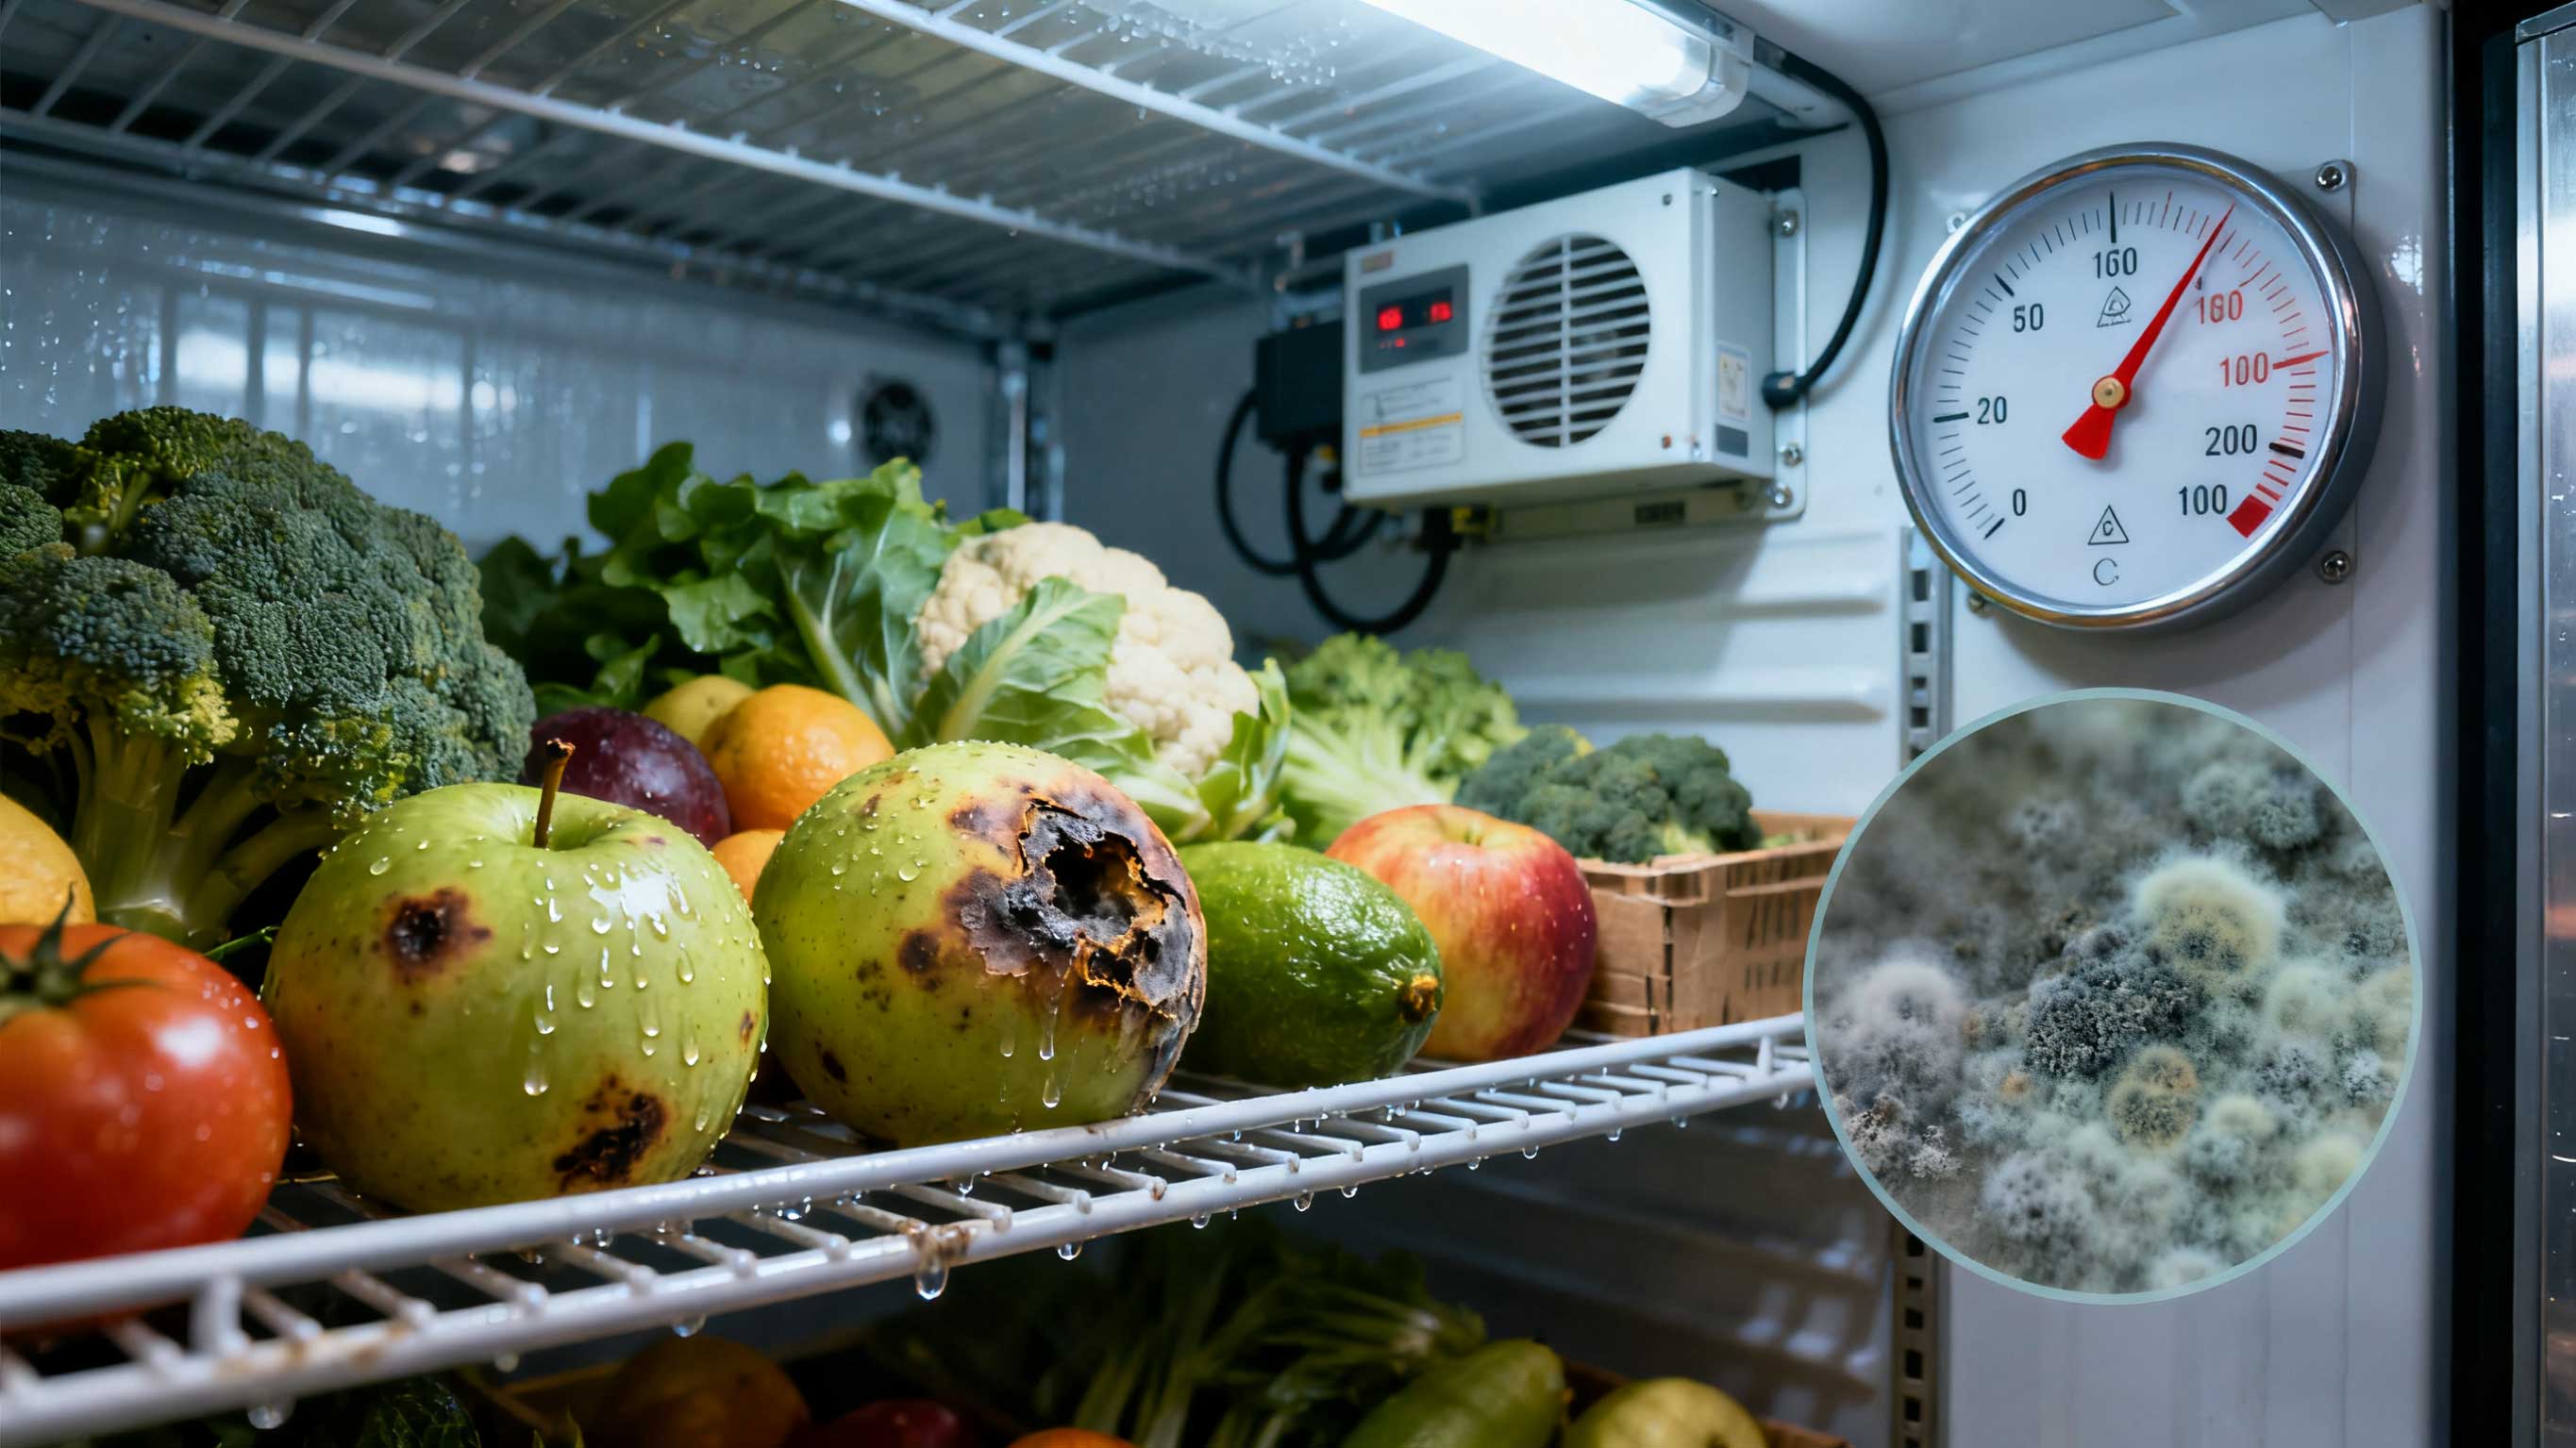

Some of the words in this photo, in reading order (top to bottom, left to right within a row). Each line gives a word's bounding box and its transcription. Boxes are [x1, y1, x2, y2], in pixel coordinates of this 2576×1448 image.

[2014, 303, 2044, 333] 50
[2219, 352, 2268, 387] 100
[1978, 396, 2007, 424] 20
[2205, 424, 2257, 456] 200
[2013, 489, 2027, 517] 0
[2179, 484, 2227, 516] 100
[2093, 558, 2119, 586] C
